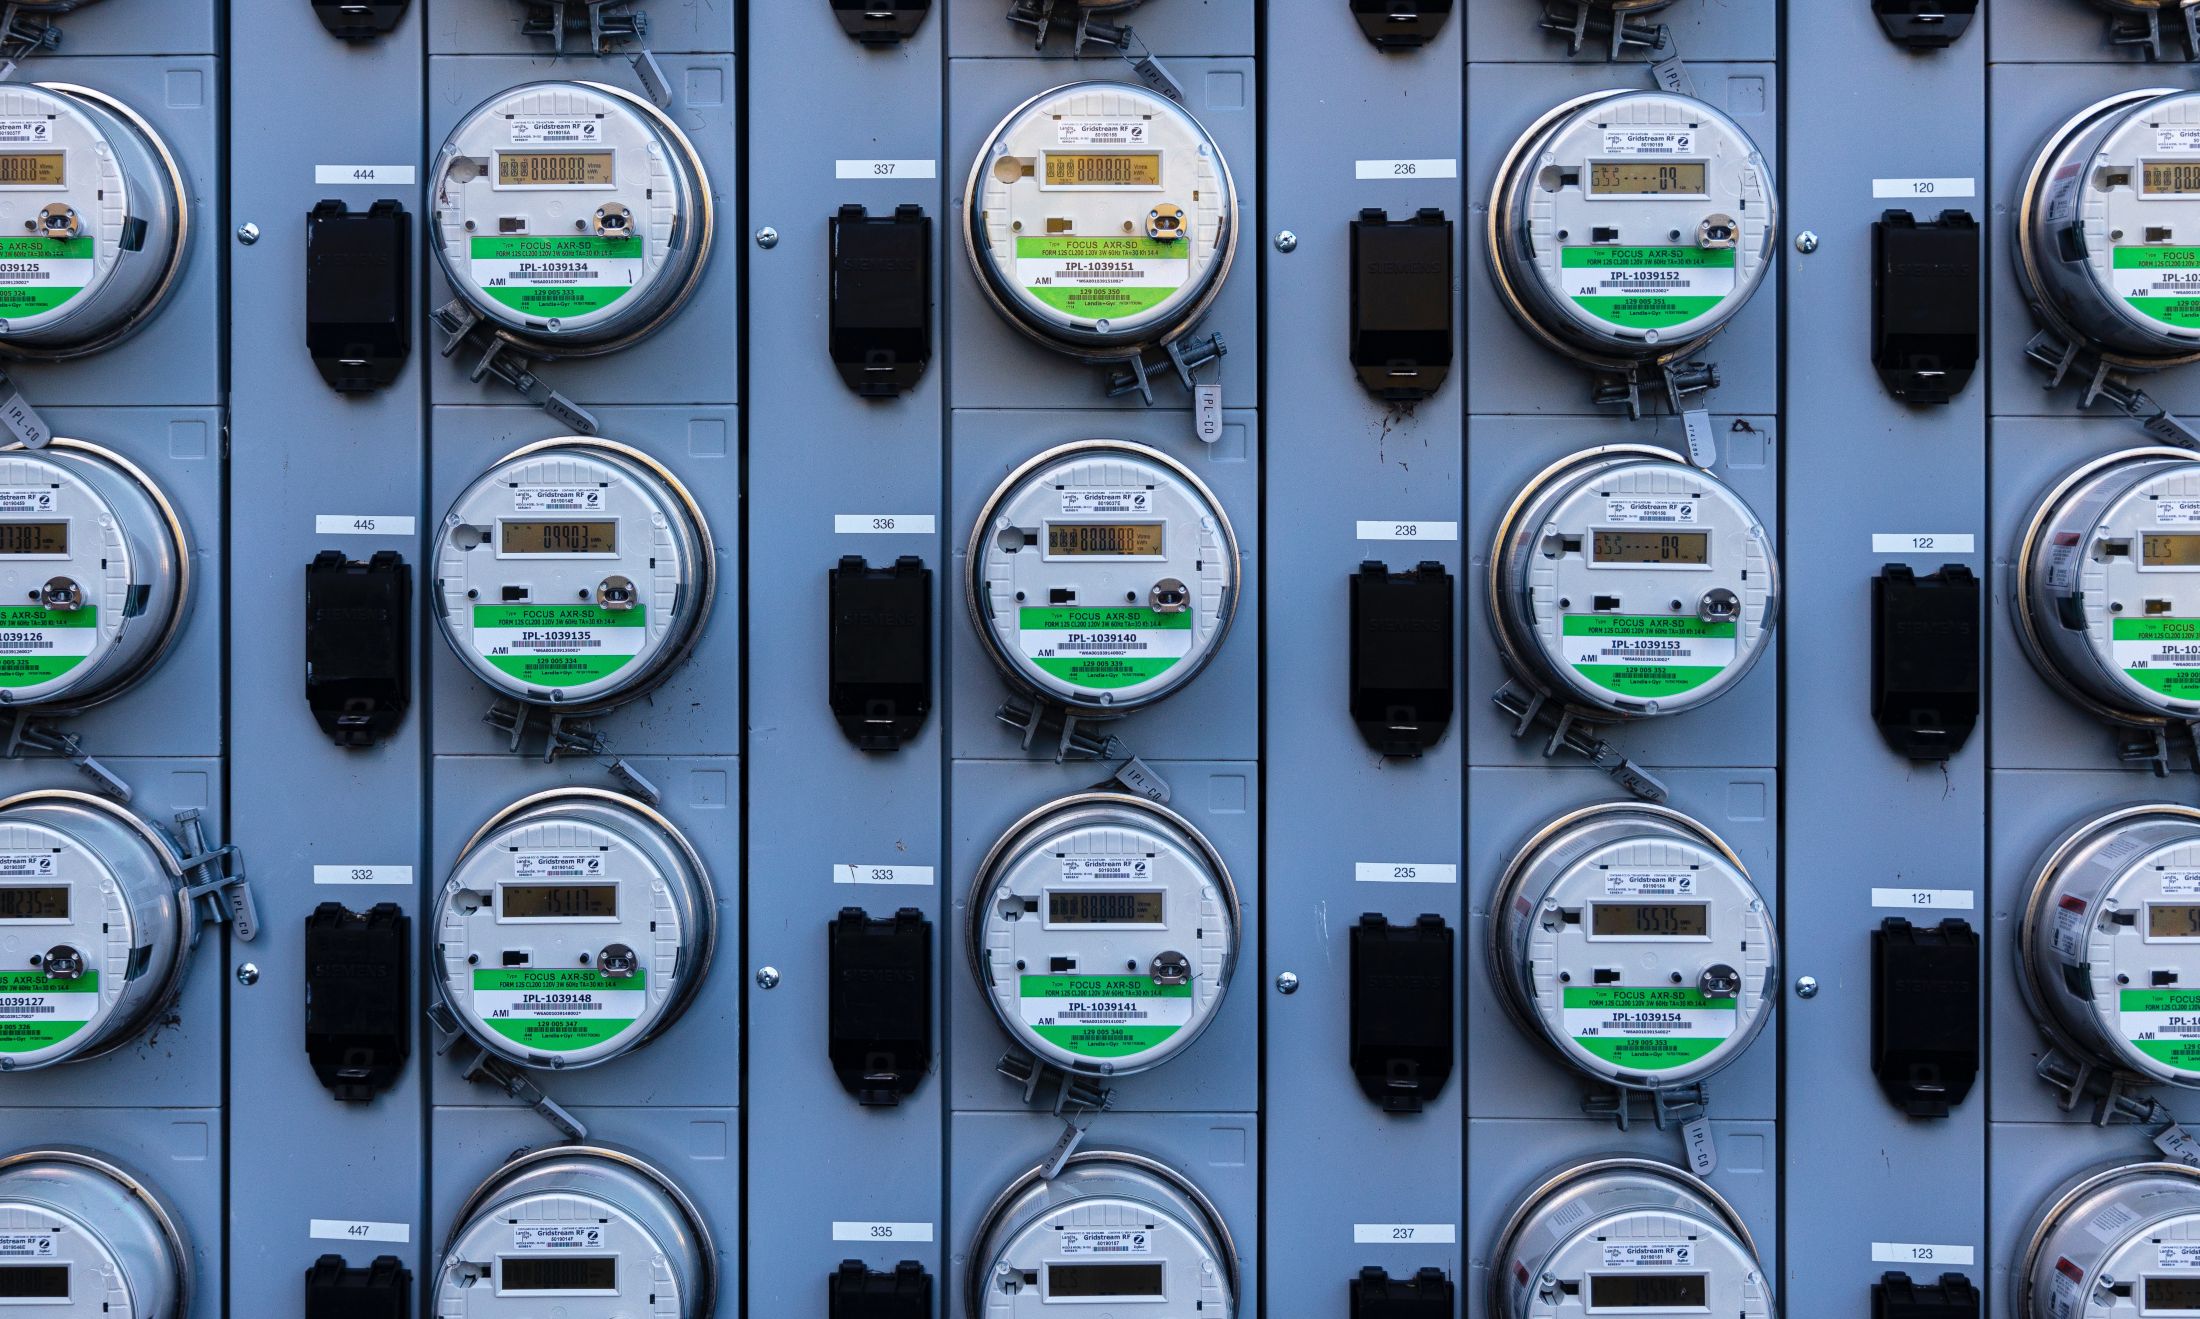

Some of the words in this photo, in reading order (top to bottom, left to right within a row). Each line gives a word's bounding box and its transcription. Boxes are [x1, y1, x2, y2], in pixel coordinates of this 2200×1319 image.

[1145, 68, 1179, 102] IPL-CO
[353, 169, 375, 180] 444
[874, 163, 895, 175] 337
[1394, 163, 1416, 175] 236
[1913, 182, 1934, 193] 120
[519, 263, 588, 271] IPL-1039134
[1066, 263, 1134, 271] IPL-1039151
[1611, 272, 1679, 280] IPL-1039152
[552, 402, 590, 431] IPL-CO
[1202, 392, 1215, 435] IPL-CO
[8, 405, 40, 443] IPL-CO
[353, 519, 375, 531] 445
[872, 518, 894, 530] 336
[1395, 524, 1417, 536] 238
[1912, 537, 1934, 549] 122
[1106, 612, 1140, 620] AXR-SD
[522, 632, 591, 640] IPL-1039135
[1068, 634, 1137, 642] IPL-1039140
[1612, 640, 1680, 648] IPL-1039153
[1127, 769, 1163, 801] IPL-CO
[1622, 773, 1659, 800] IPL-CO
[351, 869, 373, 880] 332
[871, 869, 894, 880] 333
[1394, 867, 1416, 878] 235
[1911, 893, 1931, 904] 121
[231, 895, 249, 936] IPL-CO
[523, 995, 591, 1003] IPL-1039148
[1069, 1003, 1137, 1011] IPL-1039141
[1613, 1013, 1681, 1021] IPL-1039154
[1691, 1127, 1709, 1169] IPL-CO
[347, 1225, 369, 1236] 447
[871, 1226, 893, 1237] 335
[1392, 1228, 1415, 1239] 237
[1912, 1248, 1933, 1259] 123
